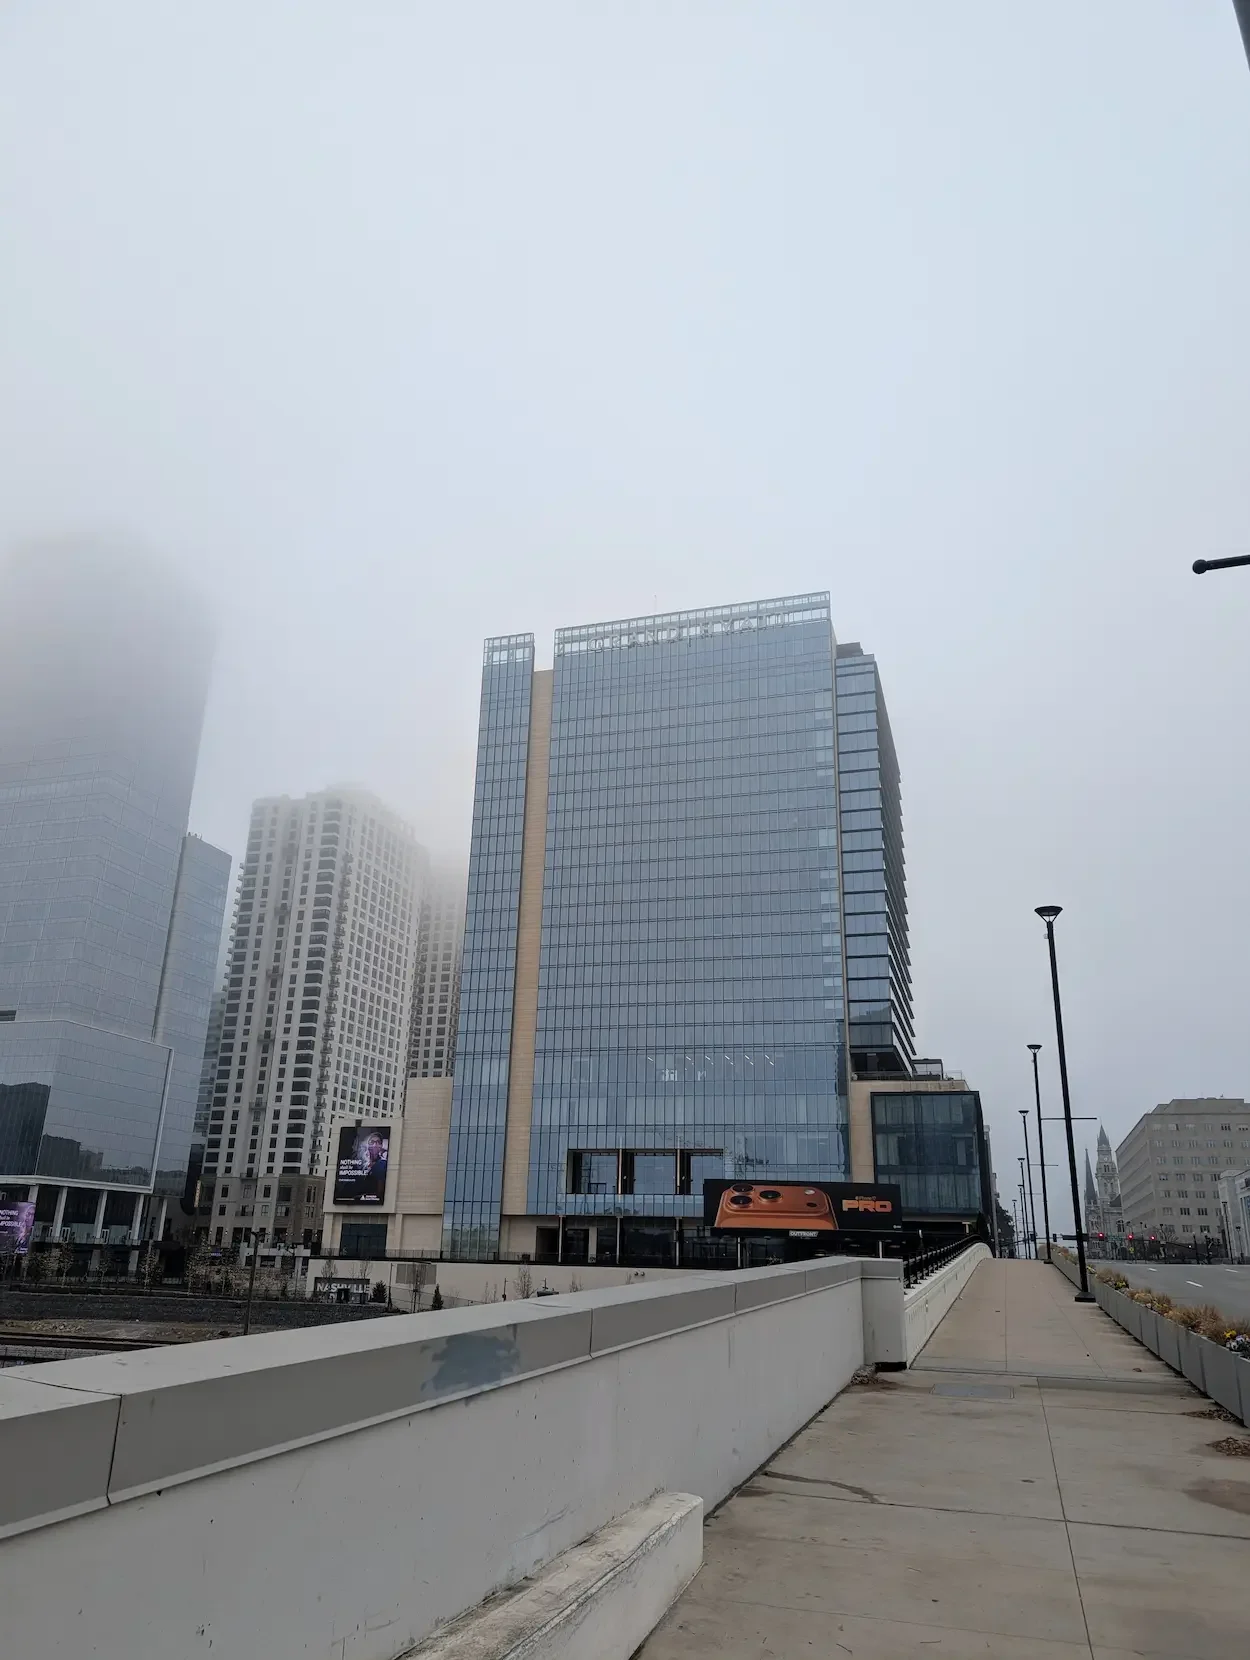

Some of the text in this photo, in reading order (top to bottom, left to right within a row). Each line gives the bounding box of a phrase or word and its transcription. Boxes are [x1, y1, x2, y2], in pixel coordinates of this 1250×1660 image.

[588, 613, 788, 651] GRAND HYATT
[842, 1200, 892, 1212] PRO
